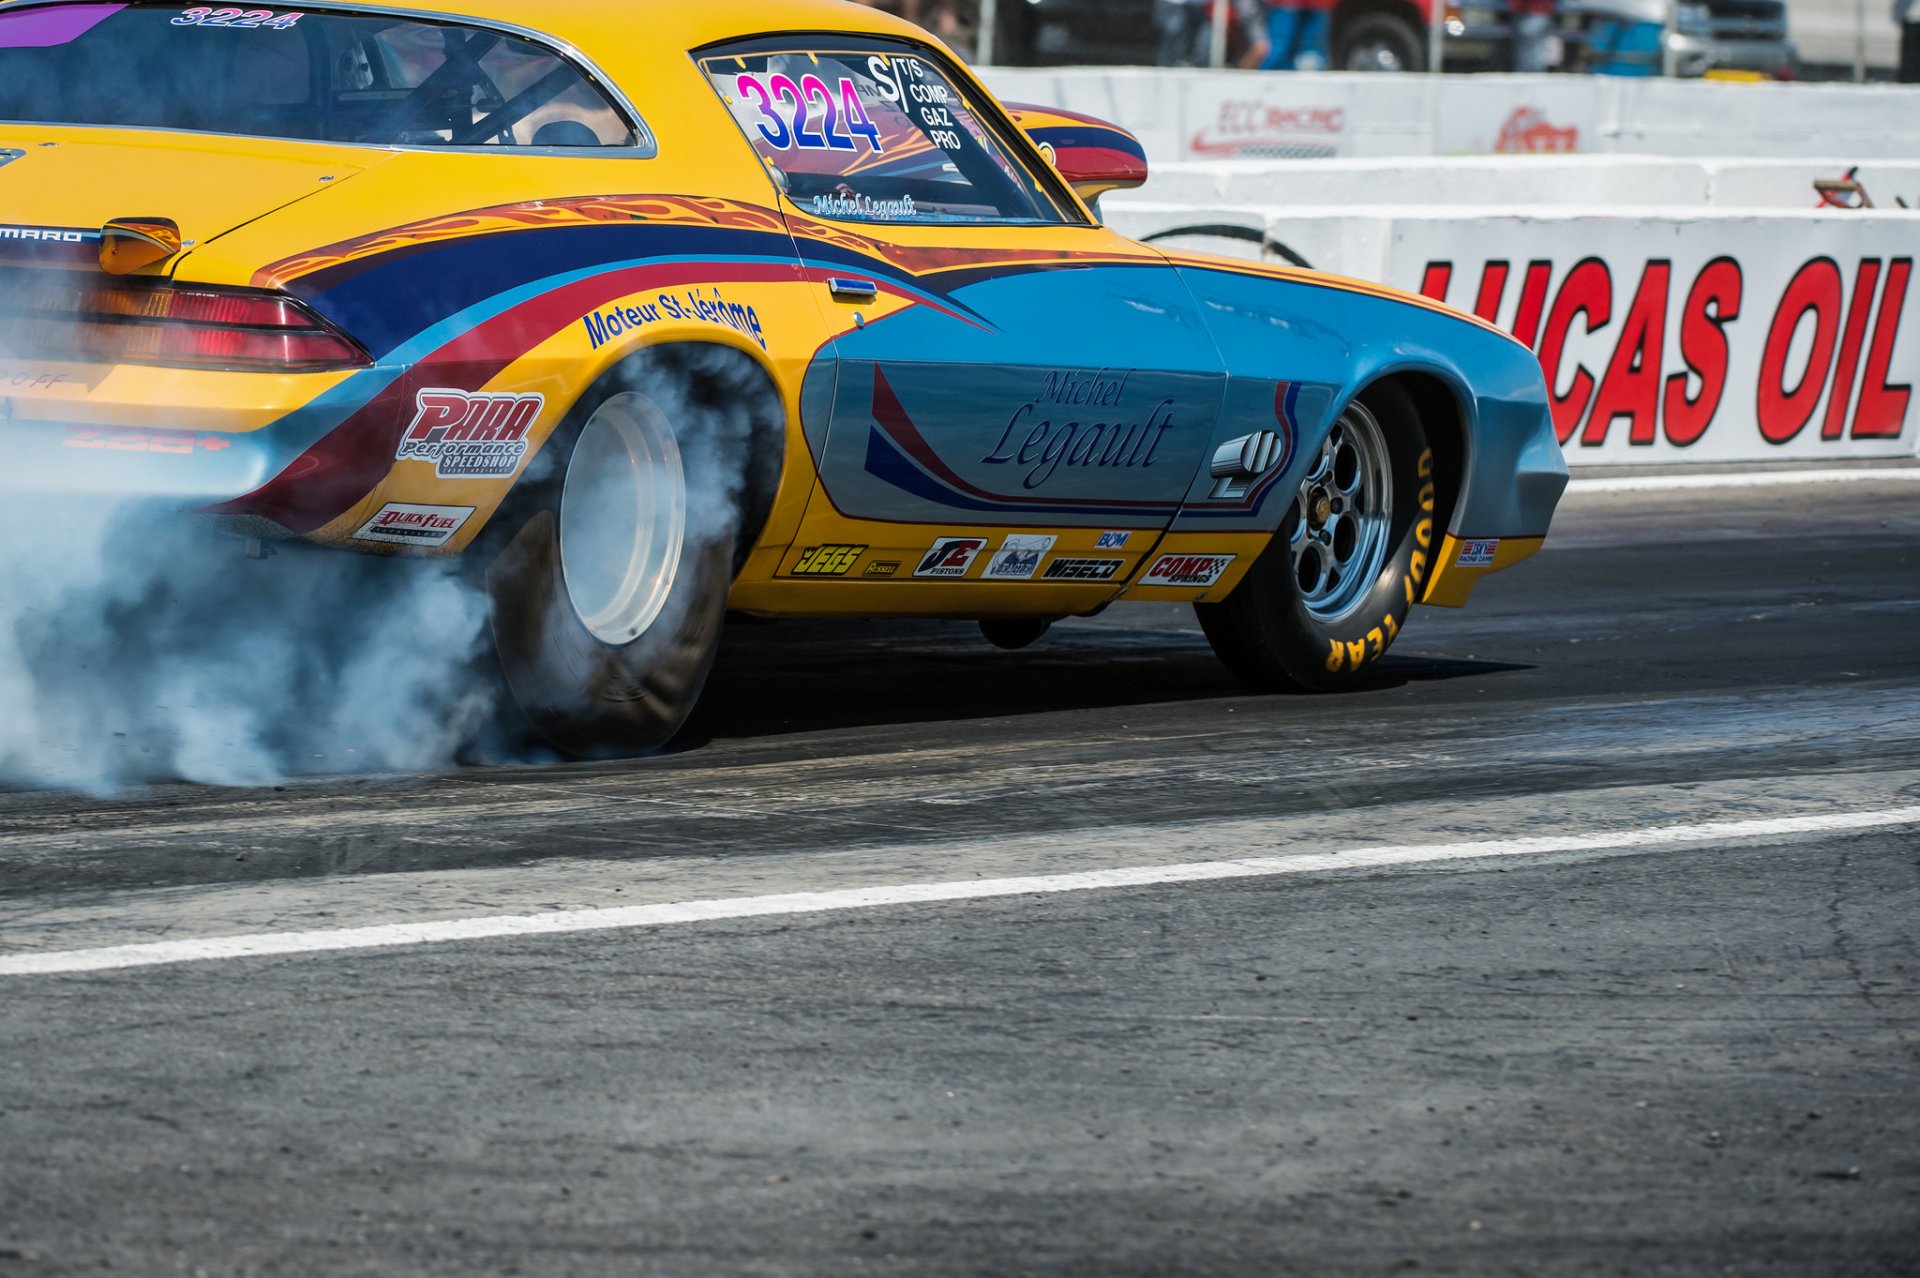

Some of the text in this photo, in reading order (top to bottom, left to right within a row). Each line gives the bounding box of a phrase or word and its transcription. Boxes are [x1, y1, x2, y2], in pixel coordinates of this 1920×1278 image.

[170, 6, 305, 30] 3224
[909, 83, 948, 104] COMP
[735, 72, 885, 154] 3224
[920, 106, 954, 127] GAZ
[929, 129, 961, 150] PRO
[813, 192, 917, 221] Michel Legault
[582, 287, 767, 351] Moteur St-Jérôme
[1419, 255, 1914, 447] CAS OIL
[1034, 367, 1136, 407] Michel
[406, 394, 541, 441] PARA
[401, 441, 525, 458] Performance
[978, 399, 1175, 489] Legault
[442, 455, 517, 468] SPEEDSHOP
[379, 511, 425, 526] QUICK
[792, 545, 867, 574] JEGS
[917, 540, 983, 573] JE
[1149, 556, 1215, 577] COMP
[930, 567, 965, 575] PISTONS
[1167, 574, 1214, 584] SPRINGS
